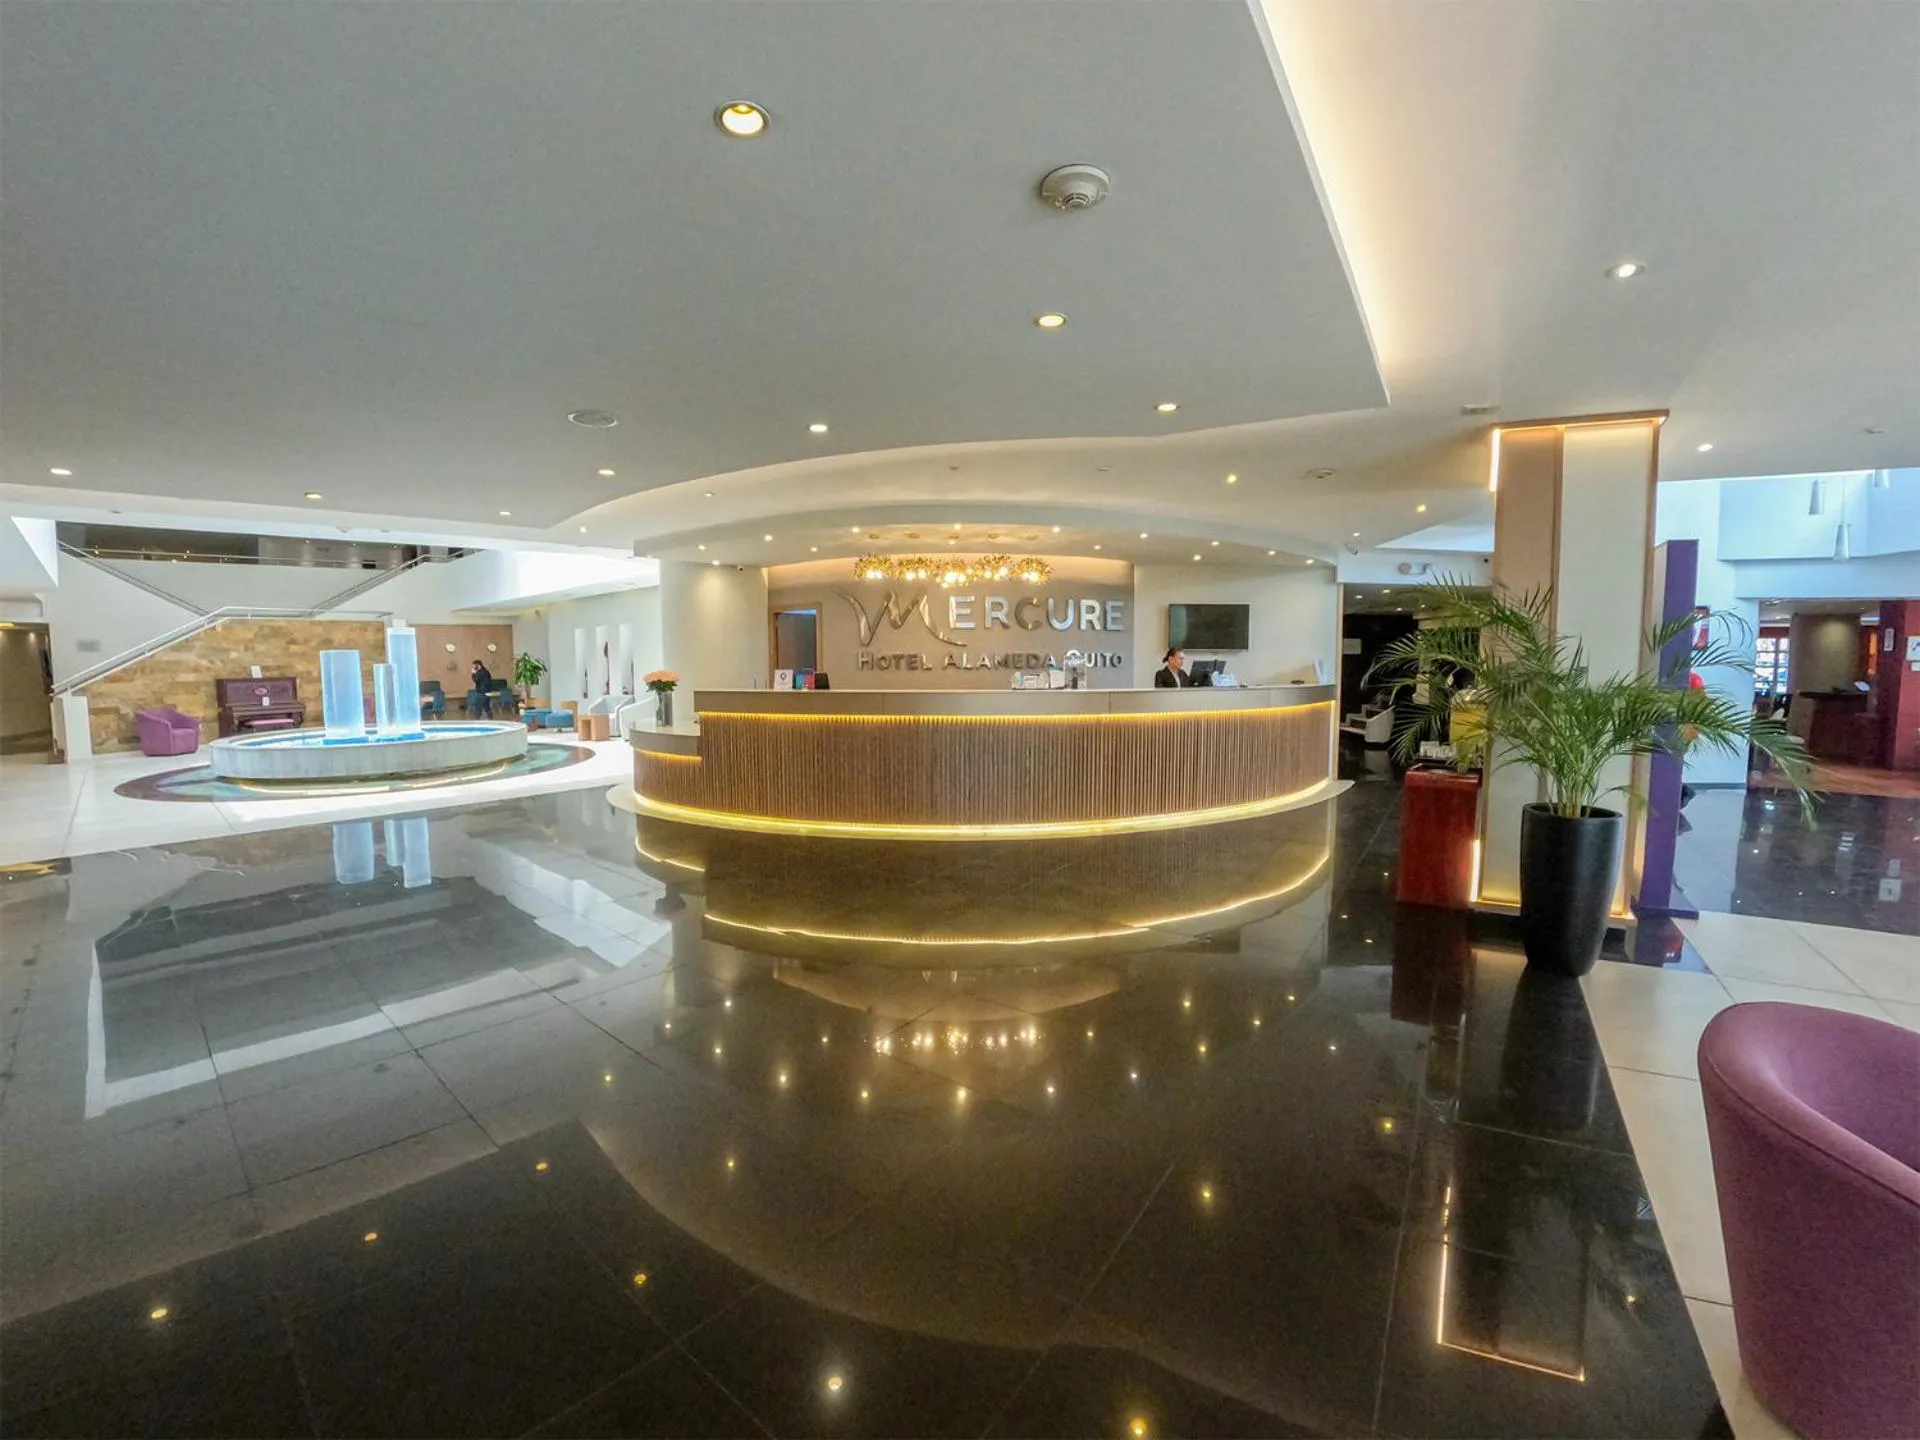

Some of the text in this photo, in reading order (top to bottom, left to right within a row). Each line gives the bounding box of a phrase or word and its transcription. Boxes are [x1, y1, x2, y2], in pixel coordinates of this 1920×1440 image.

[833, 587, 1125, 647] MERCURE
[857, 651, 933, 671] HOTEL
[942, 651, 1057, 671] ALAMEDA
